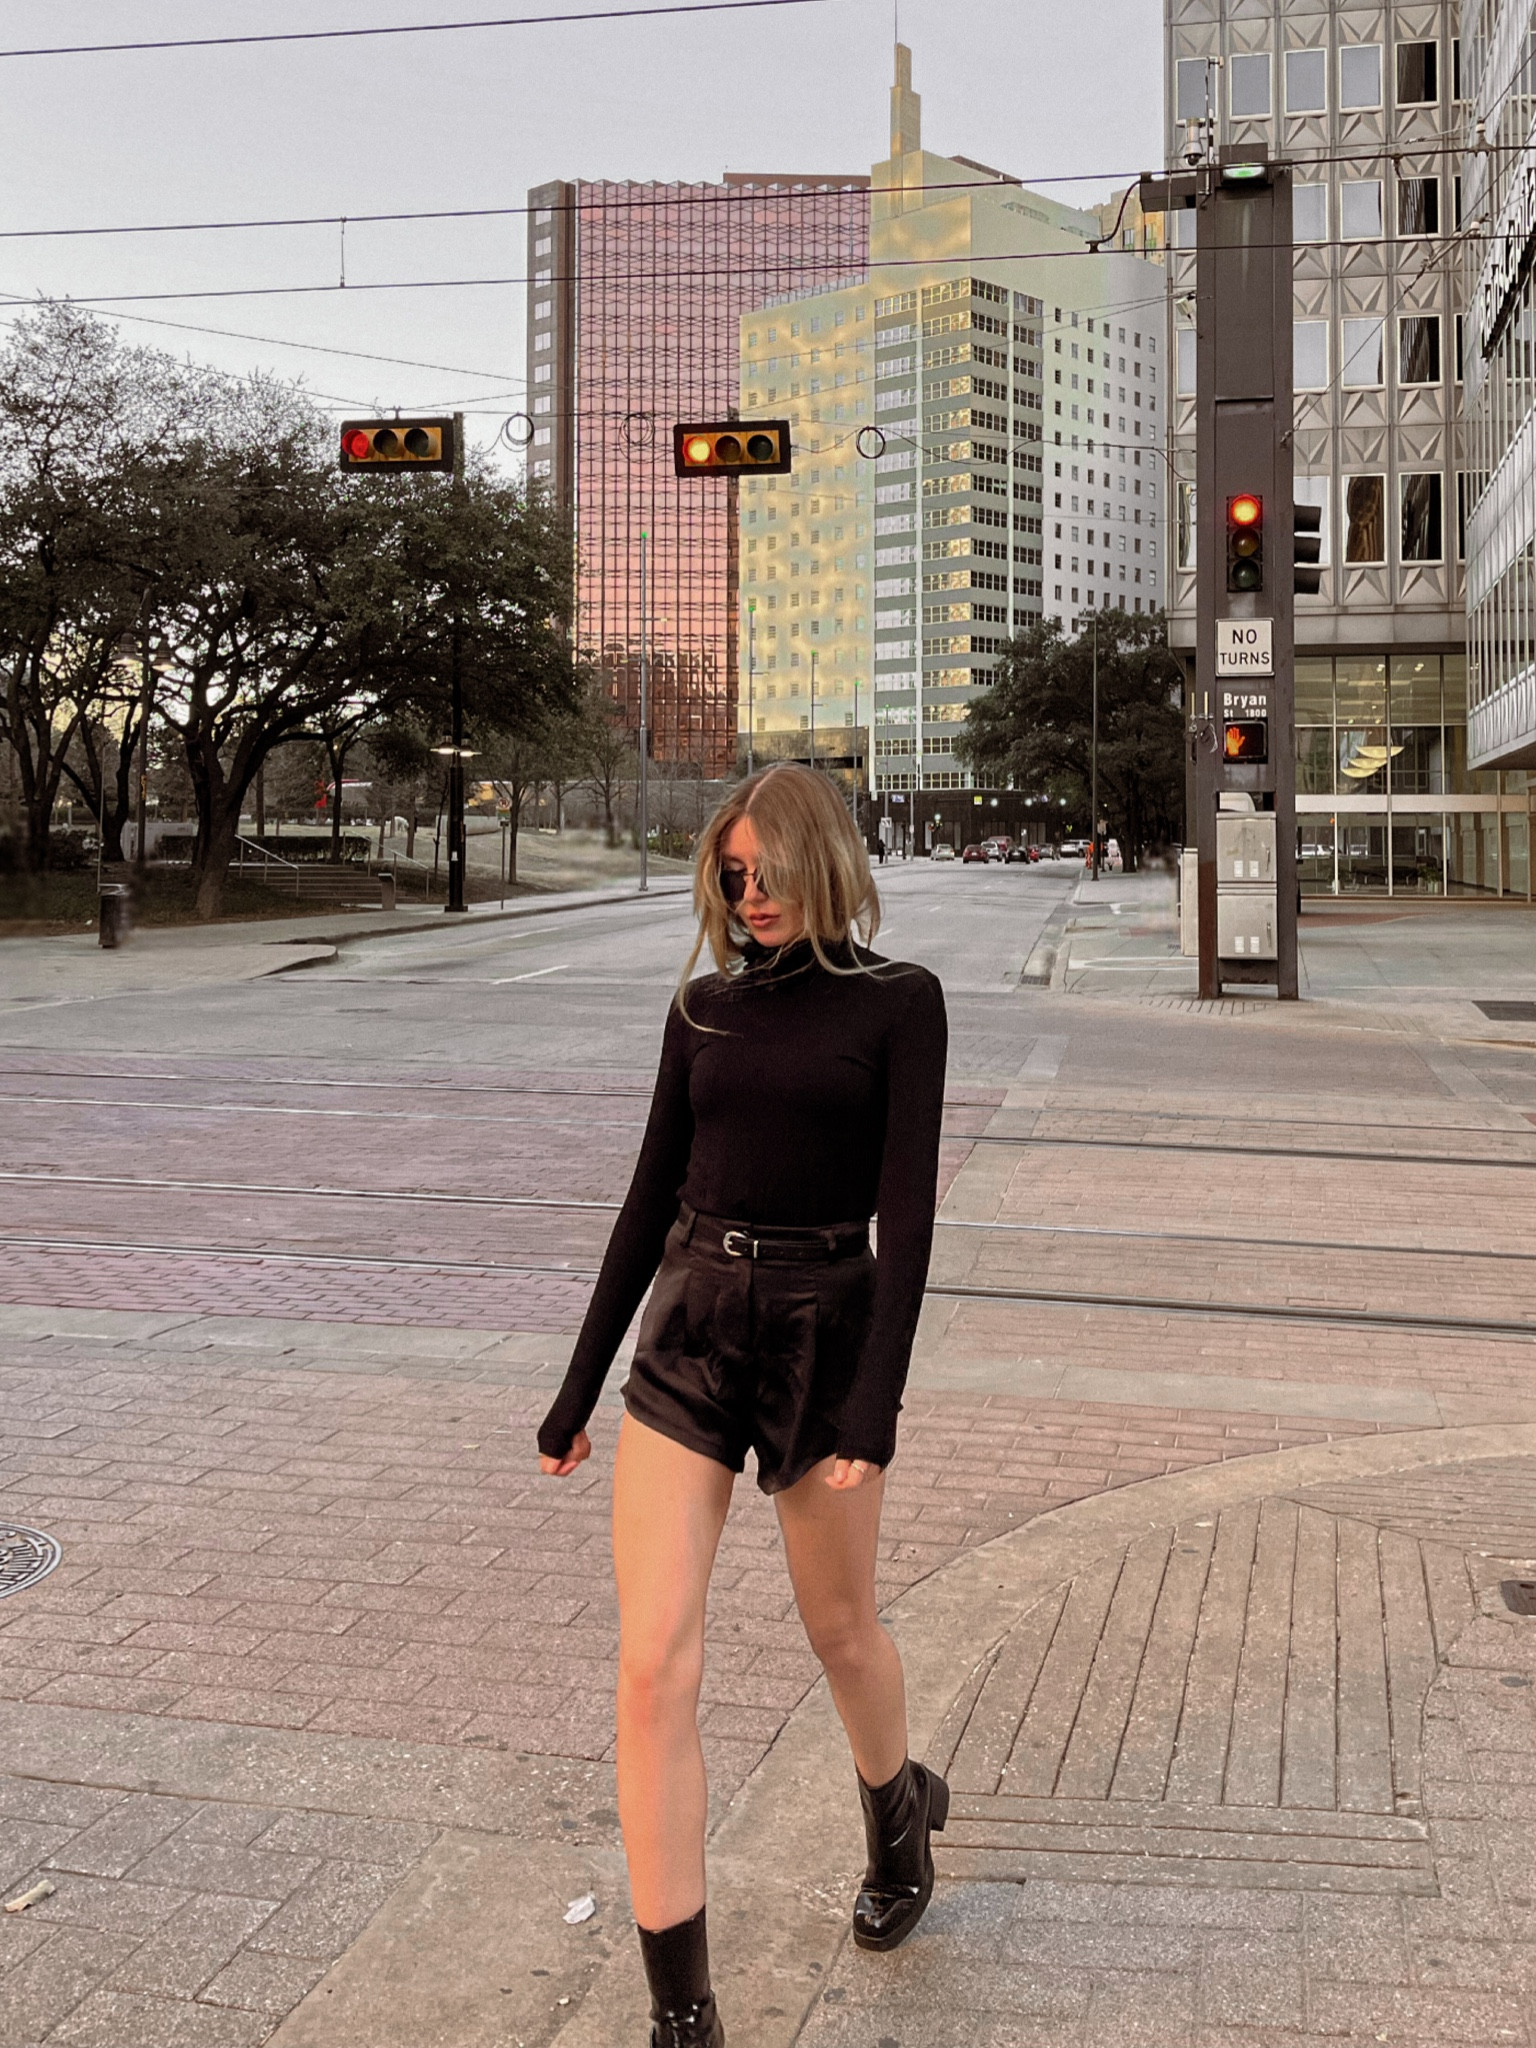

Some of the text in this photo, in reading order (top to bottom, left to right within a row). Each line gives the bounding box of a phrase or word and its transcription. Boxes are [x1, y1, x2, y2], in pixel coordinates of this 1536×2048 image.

[1232, 629, 1257, 644] NO
[1219, 651, 1270, 665] TURNS
[1223, 692, 1267, 709] Bryan
[1223, 709, 1267, 718] St 1800
